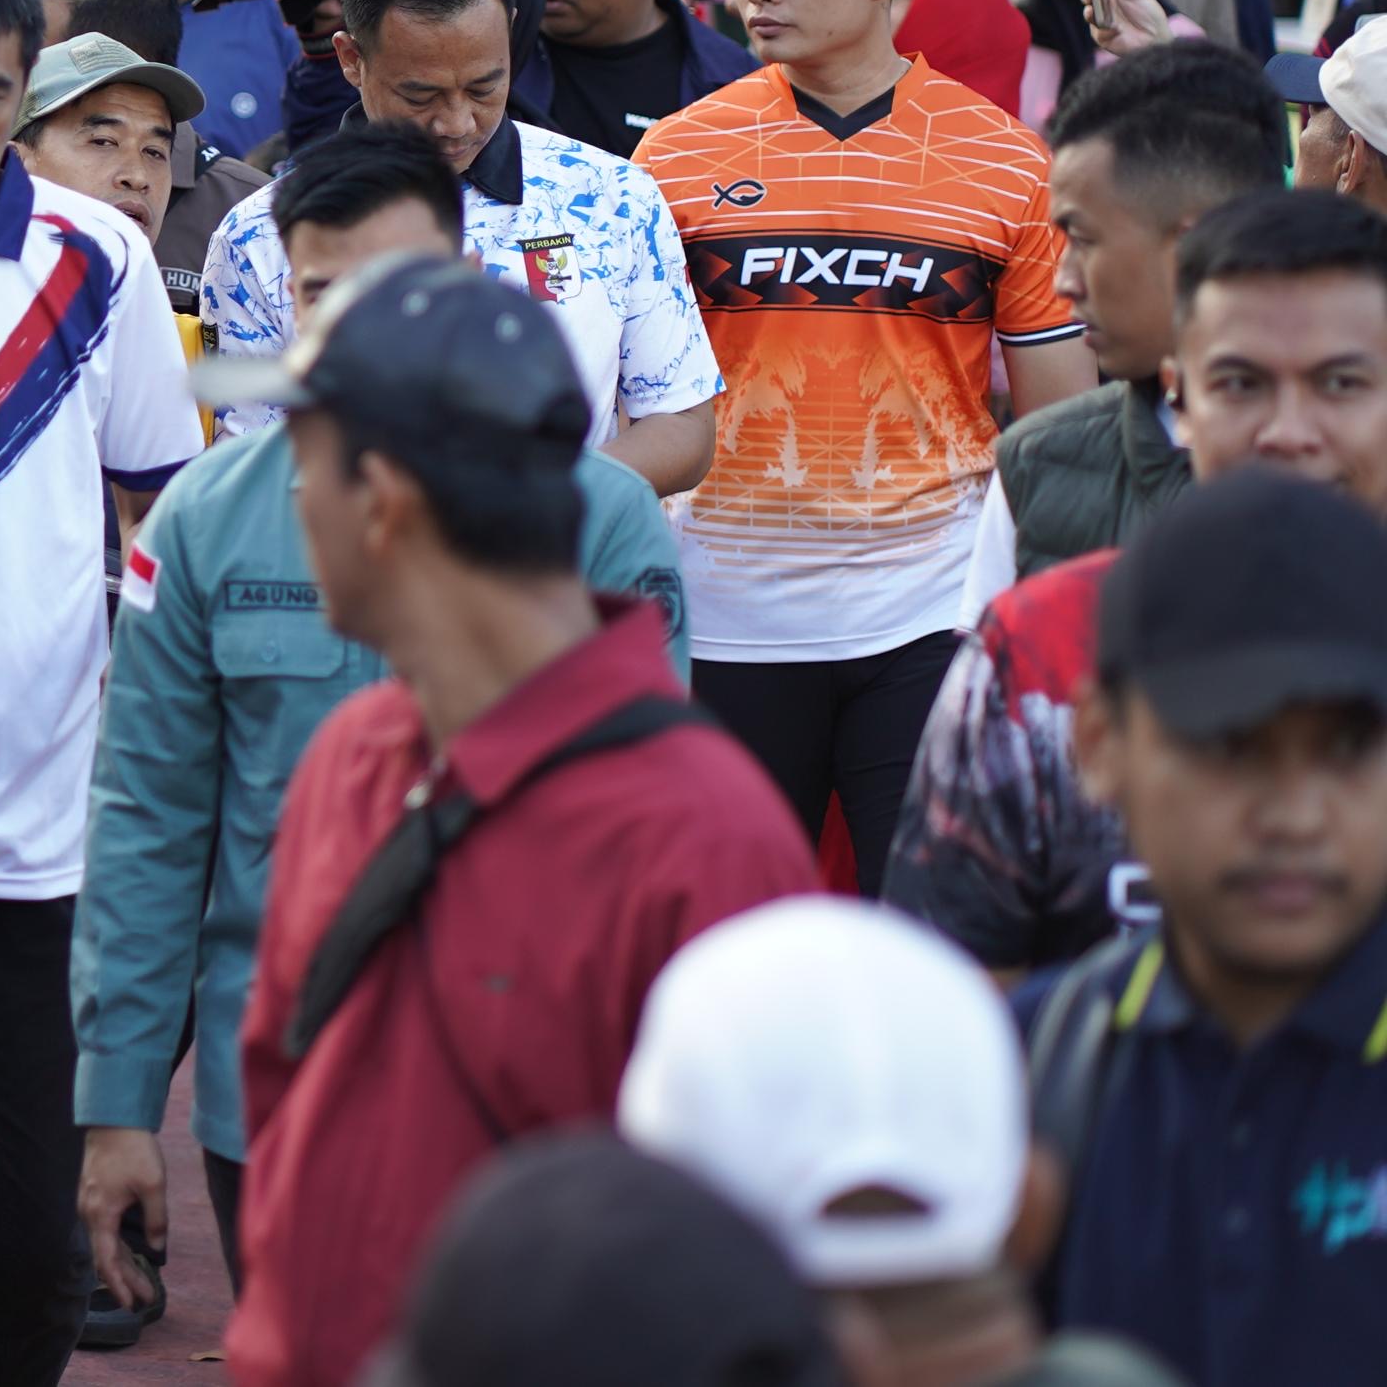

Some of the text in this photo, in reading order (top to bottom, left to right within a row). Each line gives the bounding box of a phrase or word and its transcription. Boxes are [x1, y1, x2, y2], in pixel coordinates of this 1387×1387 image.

[525, 236, 571, 250] PERBAKIN
[740, 246, 934, 293] FIXCH
[166, 271, 201, 291] HUM
